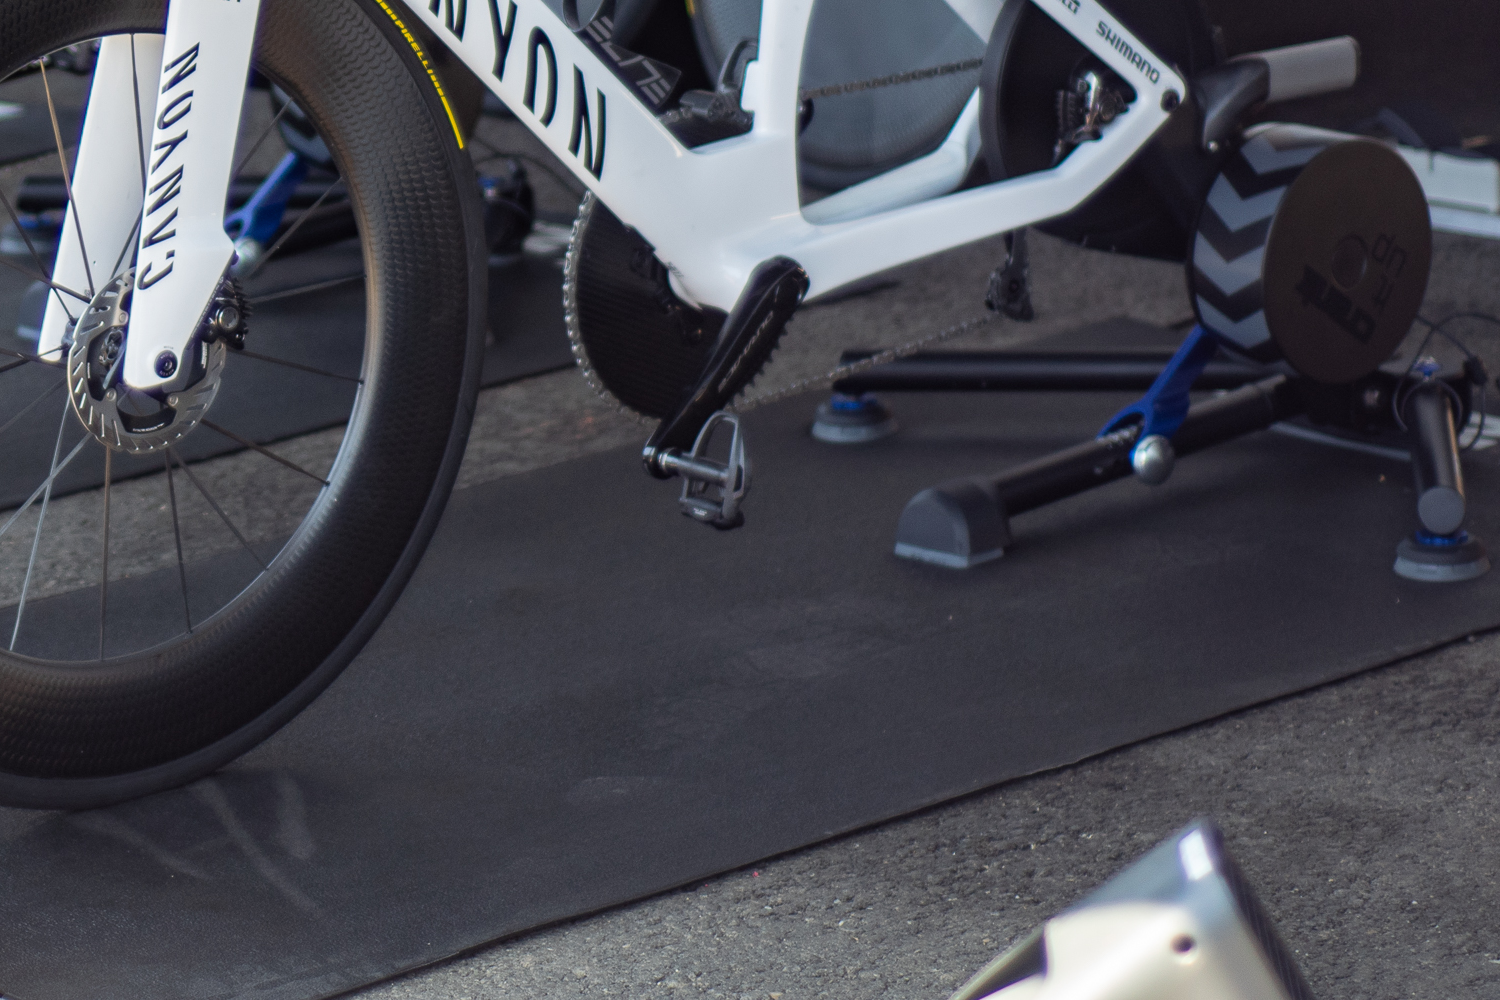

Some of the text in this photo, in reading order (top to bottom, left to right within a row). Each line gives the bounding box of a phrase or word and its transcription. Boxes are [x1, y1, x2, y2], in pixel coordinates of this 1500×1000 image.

[394, 18, 434, 76] PIRELLI
[1096, 20, 1161, 85] SHIMANO
[136, 41, 201, 291] CANYON
